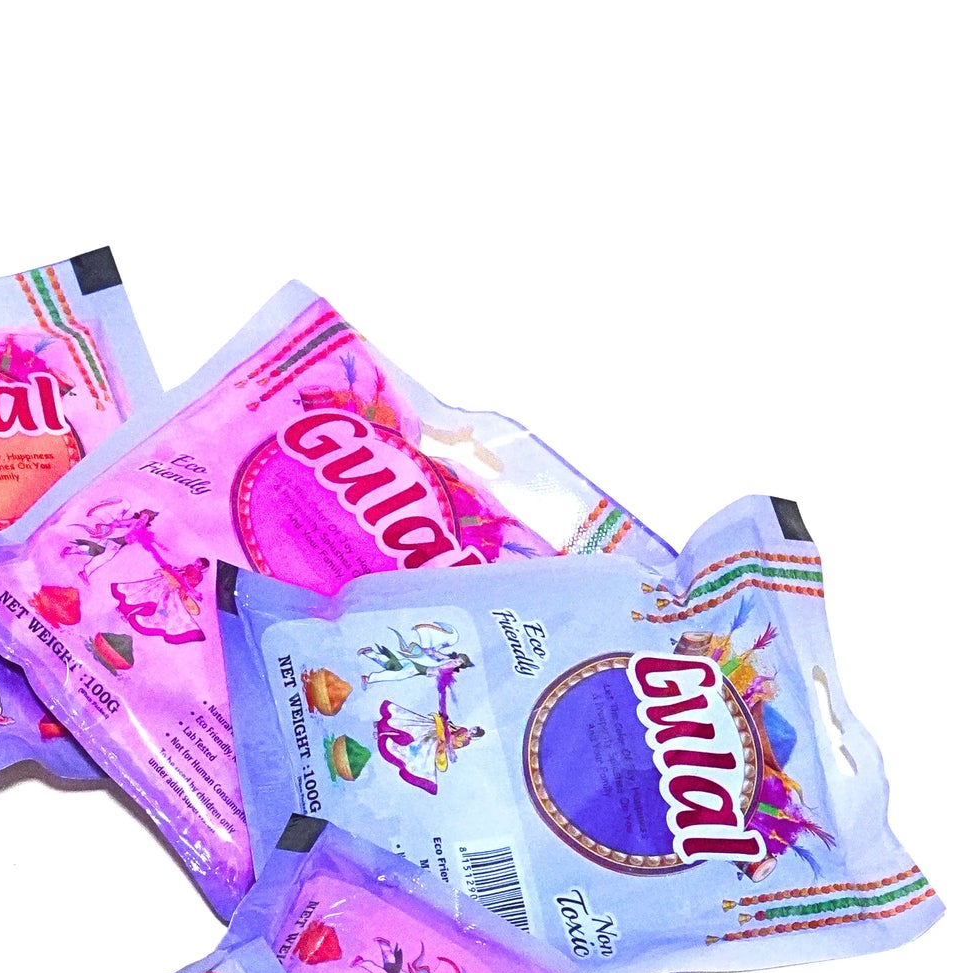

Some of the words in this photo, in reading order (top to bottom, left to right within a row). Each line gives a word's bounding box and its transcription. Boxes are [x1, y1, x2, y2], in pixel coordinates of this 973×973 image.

[7, 453, 54, 462] Happiness
[170, 453, 207, 475] Eco
[139, 460, 212, 495] Friendly
[29, 616, 81, 672] WEIGHT
[491, 608, 535, 677] Friendly
[522, 621, 546, 660] Eco
[195, 716, 207, 728] Eco
[278, 655, 298, 687] NET
[289, 691, 310, 760] WEIGHT
[171, 736, 185, 752] Not
[181, 750, 193, 762] for
[191, 760, 215, 786] Human
[183, 726, 195, 740] Lab
[195, 738, 217, 762] Tested
[635, 656, 760, 857] Gulal
[147, 758, 169, 778] under
[165, 778, 185, 797] adult
[197, 792, 221, 819] children
[219, 818, 236, 834] only
[432, 836, 444, 856] Eco
[294, 900, 319, 928] NET
[556, 889, 595, 958] Toxic
[591, 915, 618, 957] Non
